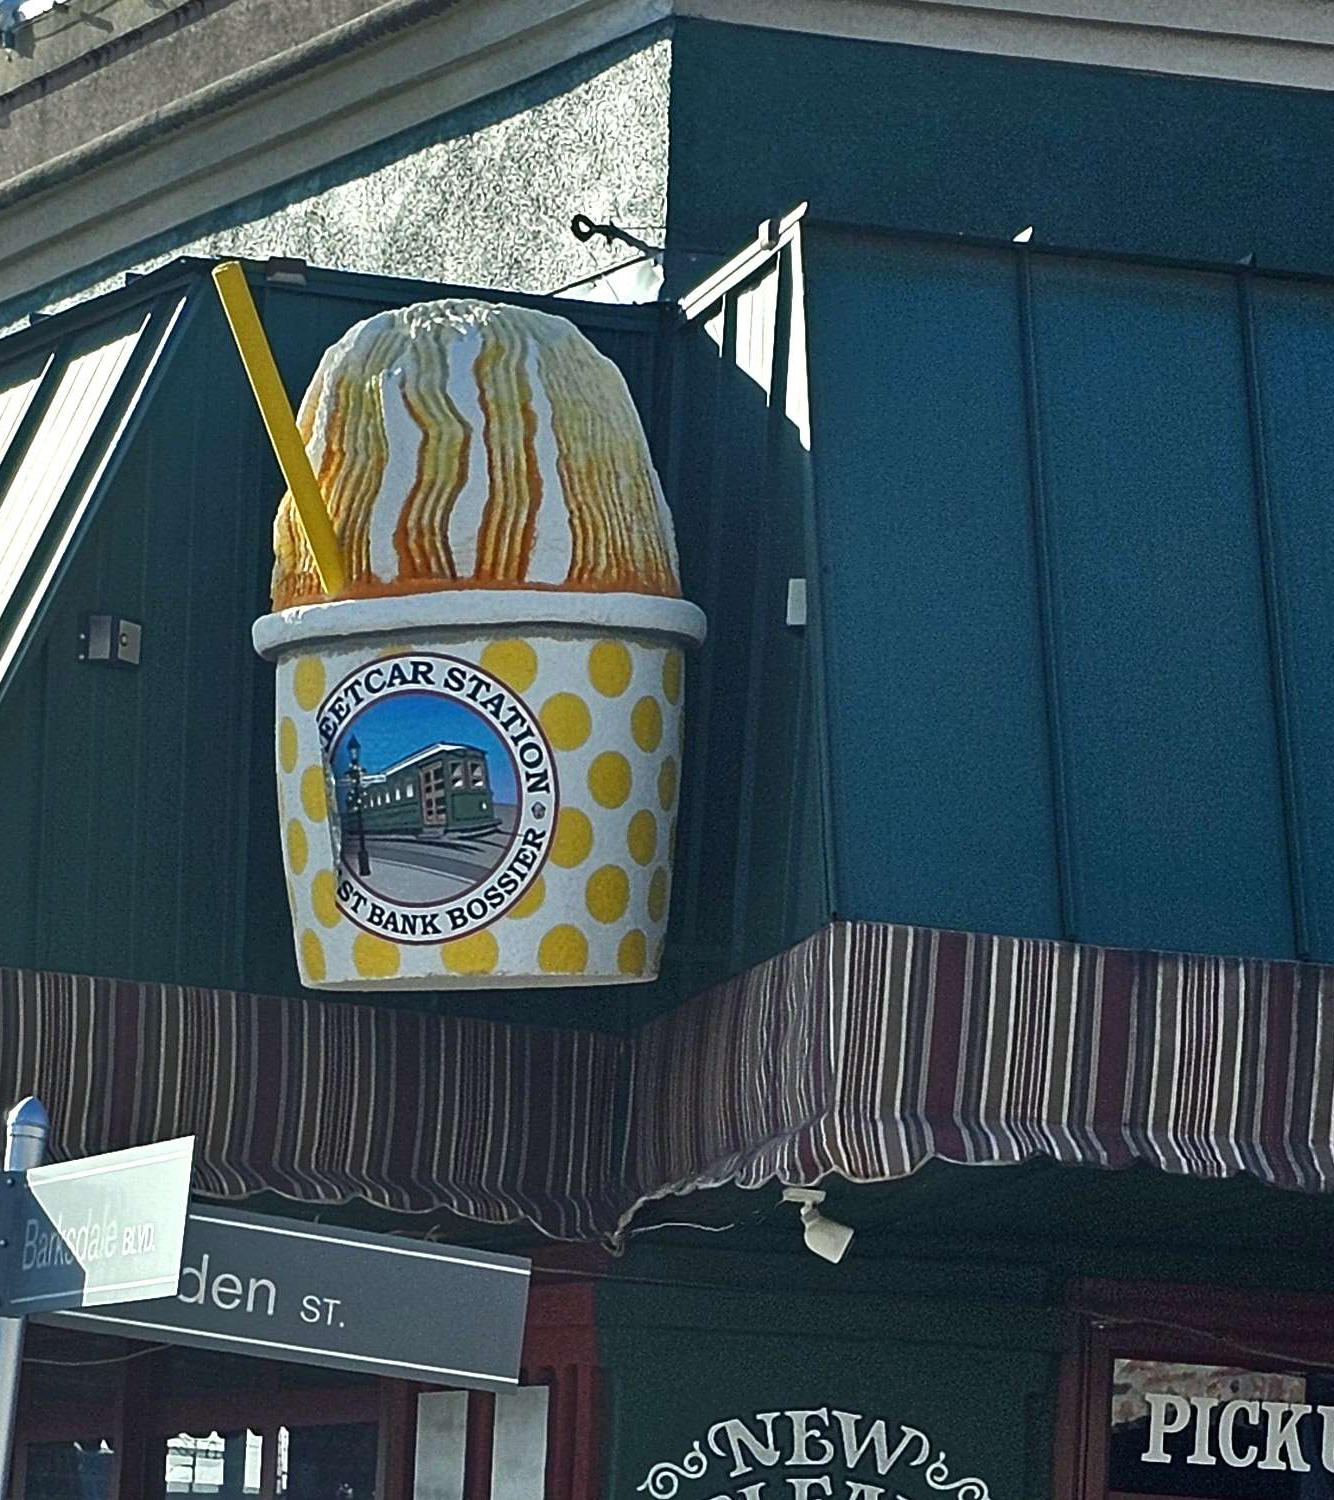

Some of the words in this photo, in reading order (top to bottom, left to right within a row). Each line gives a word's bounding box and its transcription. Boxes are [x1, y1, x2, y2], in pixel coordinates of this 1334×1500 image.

[319, 660, 435, 752] EETCAR
[443, 666, 550, 794] STATION
[337, 879, 368, 915] ST
[367, 904, 442, 935] BANK
[447, 827, 547, 930] BOSSIER
[22, 1204, 118, 1271] Barksdale
[122, 1223, 155, 1257] BLVD.
[177, 1255, 276, 1316] den
[300, 1295, 345, 1328] ST.
[708, 1407, 929, 1478] NEW
